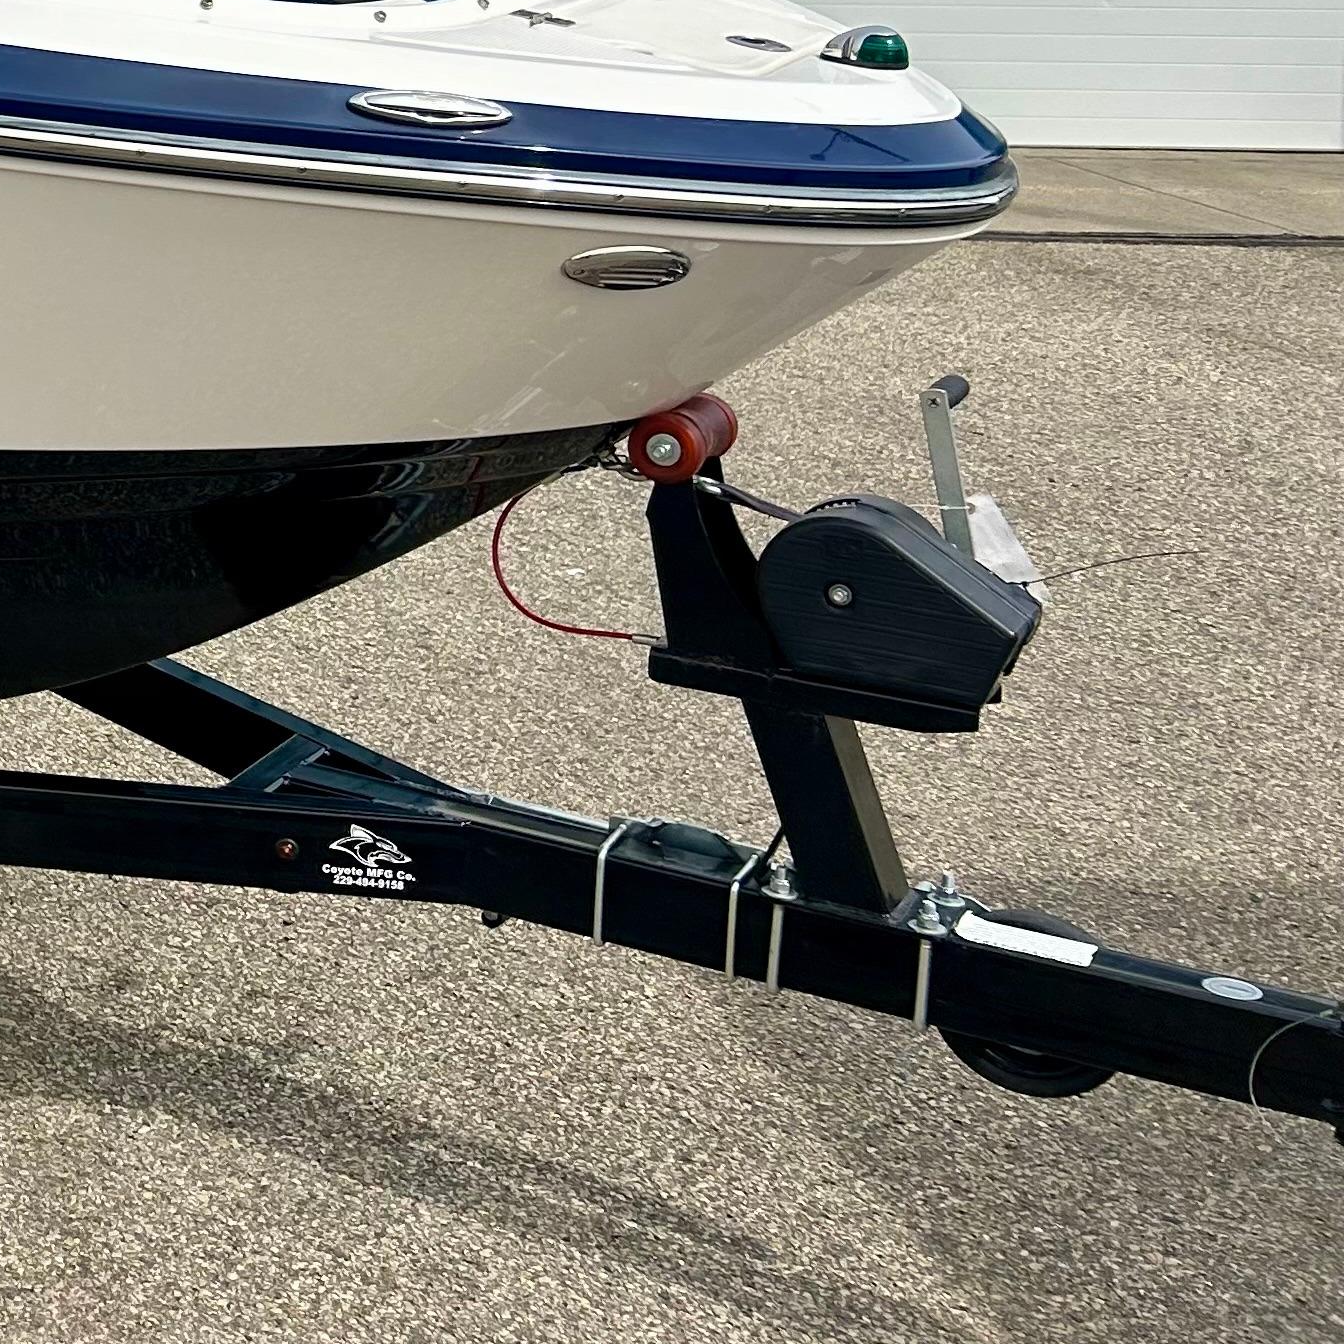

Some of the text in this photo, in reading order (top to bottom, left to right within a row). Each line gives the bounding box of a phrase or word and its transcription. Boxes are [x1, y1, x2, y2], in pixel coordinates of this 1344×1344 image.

[321, 863, 416, 882] Coyote MFG Co.
